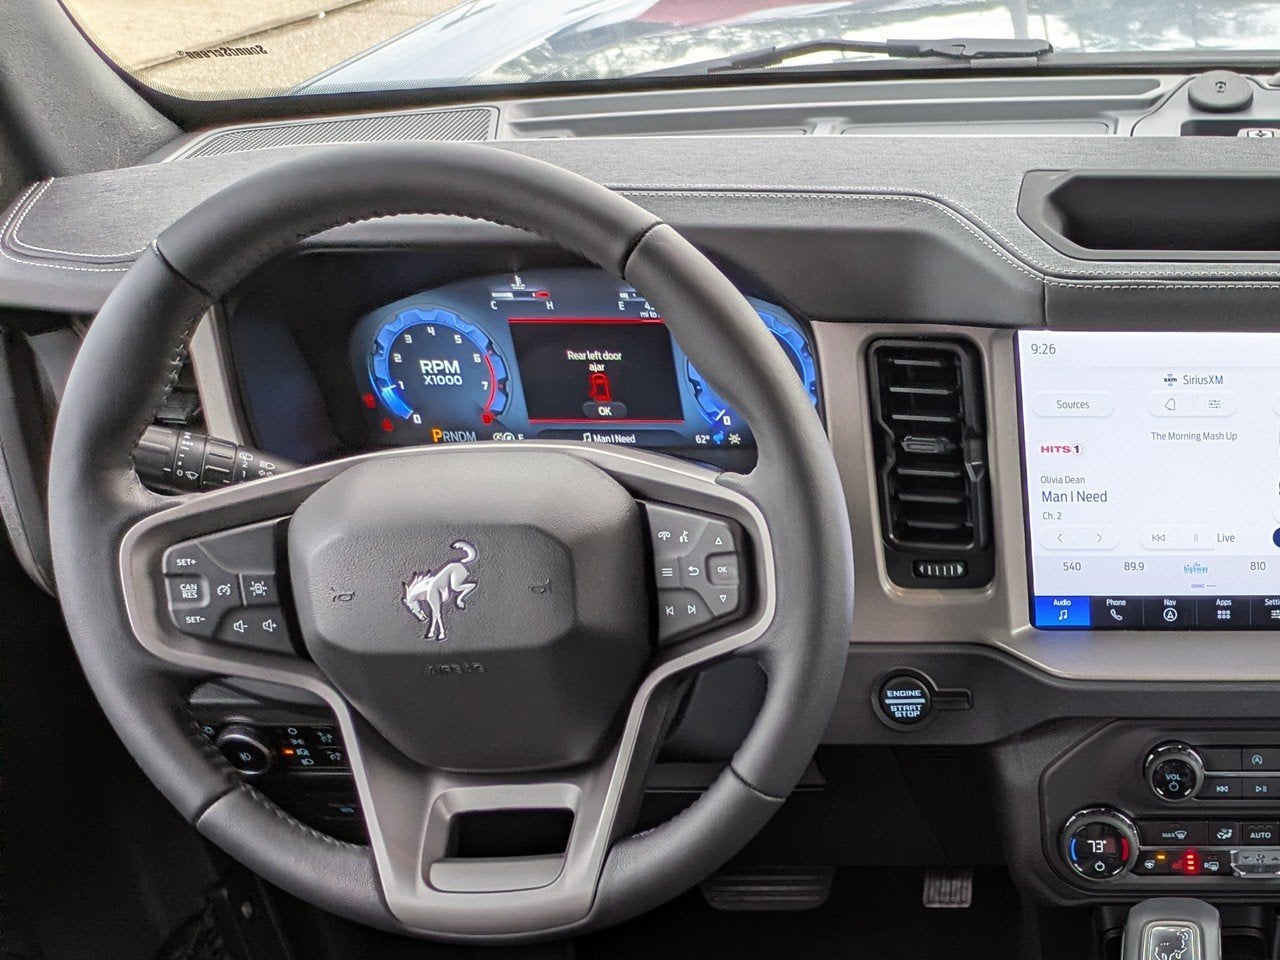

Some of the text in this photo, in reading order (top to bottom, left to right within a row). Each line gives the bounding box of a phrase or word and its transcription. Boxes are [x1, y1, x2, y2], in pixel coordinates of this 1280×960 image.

[490, 301, 498, 310] C
[546, 301, 554, 310] H
[618, 301, 625, 310] E
[426, 326, 436, 336] 4
[404, 335, 413, 344] 3
[454, 335, 462, 344] 5
[1031, 343, 1056, 355] 9:26
[393, 354, 402, 363] 2
[473, 354, 481, 363] 6
[567, 351, 622, 361] Rear left door
[419, 360, 461, 374] RPM
[589, 362, 605, 372] ajar
[424, 375, 462, 385] X1000
[1183, 375, 1224, 385] SiriusXM
[398, 381, 405, 389] 1
[481, 381, 489, 390] 7
[1056, 400, 1089, 409] Sources
[598, 406, 612, 416] OK
[413, 414, 422, 424] 0
[723, 415, 731, 425] 0
[593, 434, 609, 443] Man
[614, 434, 636, 443] Need
[695, 434, 710, 444] 62°
[1151, 432, 1238, 442] The Morning Mash Up
[1040, 446, 1071, 454] HITS
[1040, 475, 1085, 484] Olivia Dean
[1041, 491, 1068, 502] Man
[1077, 491, 1108, 503] Need
[1042, 511, 1062, 520] Ch. 2
[1217, 533, 1236, 543] Live
[176, 558, 197, 566] SET+
[1124, 562, 1145, 571] 89.9
[1250, 561, 1266, 571] 810
[1063, 562, 1082, 572] 540
[1184, 564, 1209, 574] highway
[180, 583, 198, 591] CAN
[182, 590, 198, 599] RES
[1106, 599, 1127, 607] Phone
[1215, 599, 1232, 608] Apps
[886, 689, 921, 697] ENGINE
[890, 704, 922, 712] START
[1165, 773, 1182, 781] VOL
[1087, 840, 1107, 853] 73°
